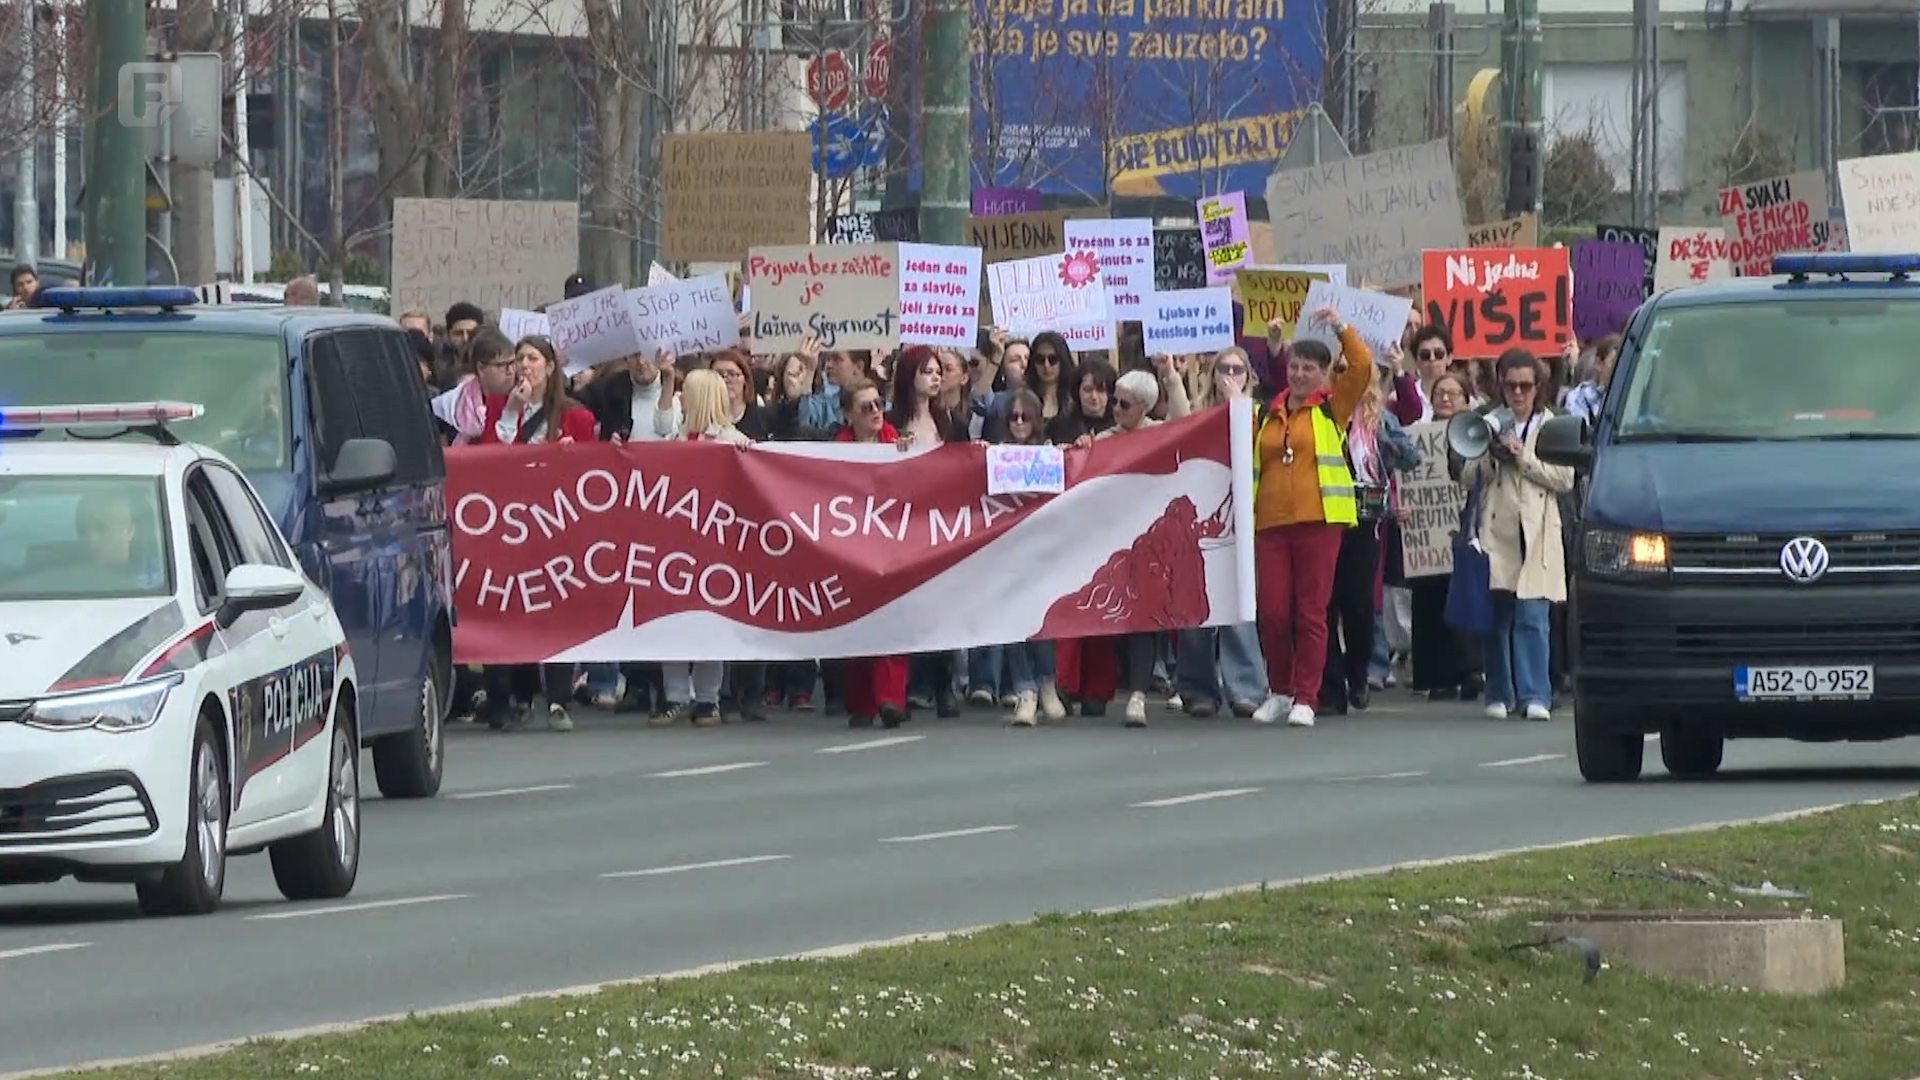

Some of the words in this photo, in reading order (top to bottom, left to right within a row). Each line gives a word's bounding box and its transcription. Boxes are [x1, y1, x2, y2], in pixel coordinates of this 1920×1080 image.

[1029, 23, 1059, 62] je
[1067, 29, 1119, 57] sve
[1128, 26, 1269, 61] zauzeto?
[1114, 142, 1150, 171] NE
[1156, 130, 1218, 167] BUDI
[1223, 122, 1267, 158] TAJ
[1719, 187, 1745, 216] ZA
[1745, 178, 1791, 210] SVAKI
[835, 211, 872, 233] NAŠ
[1736, 201, 1810, 238] FEMICID
[972, 220, 1057, 251] NIJEDNA
[1119, 236, 1132, 248] se
[1136, 235, 1151, 247] za
[1468, 221, 1523, 247] KRIV?
[1729, 222, 1811, 264] ODGOVORNE
[1811, 220, 1830, 247] SU
[750, 255, 808, 286] Prijava
[808, 251, 838, 277] bez
[841, 253, 892, 278] zaštite
[906, 260, 940, 274] Jedan
[945, 262, 968, 276] dan
[1100, 254, 1132, 266] inuta
[1445, 254, 1475, 291] Ni
[1477, 253, 1541, 292] jedna
[799, 281, 824, 306] je
[904, 282, 918, 292] za
[922, 281, 966, 297] slavlje,
[1245, 273, 1311, 294] SUDOV
[551, 303, 581, 328] STOP
[591, 293, 619, 316] THE
[638, 292, 681, 318] STOP
[688, 286, 723, 305] THE
[926, 301, 958, 316] život
[962, 305, 975, 317] za
[1158, 306, 1200, 322] Ljubav
[1204, 304, 1217, 319] je
[1247, 296, 1301, 324] POŽUR
[1427, 275, 1567, 345] VIŠE!
[555, 309, 632, 351] GENOCIDE
[638, 321, 682, 343] WAR
[691, 316, 709, 333] IN
[753, 310, 803, 340] Lažna
[808, 306, 898, 348] Sigurnost
[899, 322, 967, 339] poštovanje
[1060, 326, 1105, 341] oluciji
[1147, 324, 1198, 340] ženskog
[1201, 321, 1231, 336] roda
[673, 329, 722, 356] IRAN
[454, 468, 912, 557] OSMOMARTOVSKI
[1404, 530, 1430, 549] ONI
[477, 540, 851, 622] HERCEGOVINE
[264, 663, 325, 738] POLICIJA
